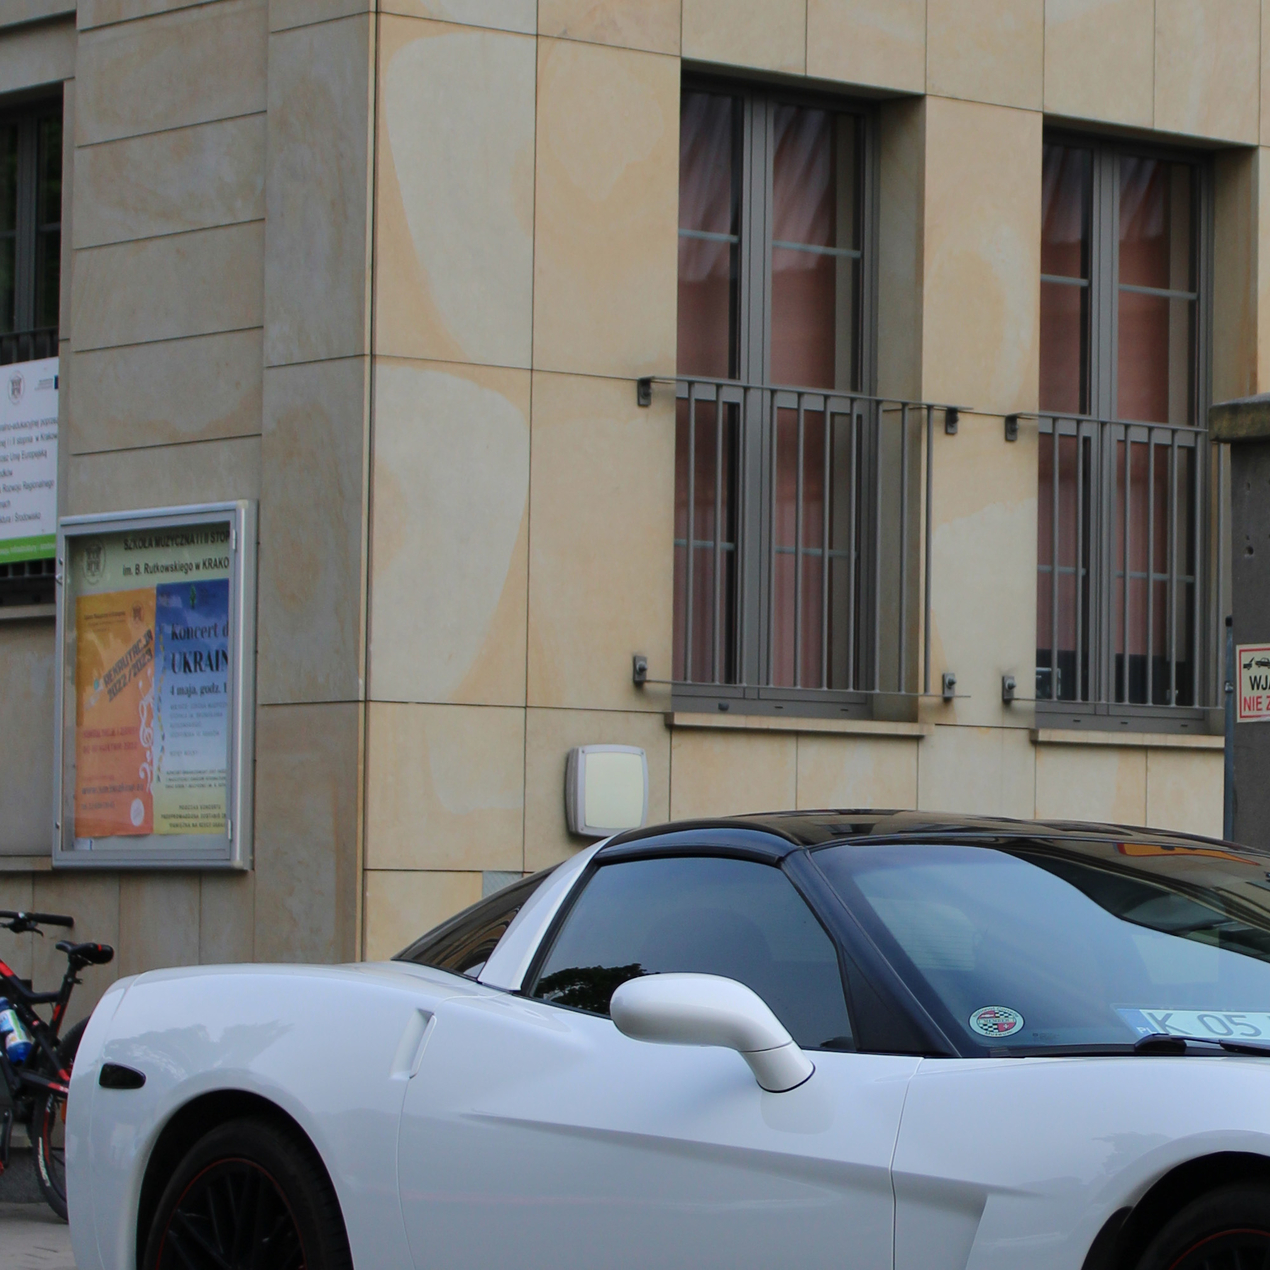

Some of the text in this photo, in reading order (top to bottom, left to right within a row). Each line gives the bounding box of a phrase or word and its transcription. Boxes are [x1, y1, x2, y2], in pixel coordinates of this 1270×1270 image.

[124, 537, 154, 551] SZKOŁA
[154, 533, 195, 549] MUZYCZNA
[135, 563, 142, 575] B.
[144, 560, 193, 576] Rutkowskiego
[195, 562, 201, 570] w
[202, 556, 229, 570] KRAKO
[171, 622, 219, 641] Koncert
[103, 628, 154, 688] REKRUTACJA
[176, 682, 198, 699] maja,
[199, 681, 221, 698] godz.
[1243, 695, 1263, 712] NIE
[1148, 1012, 1193, 1036] K
